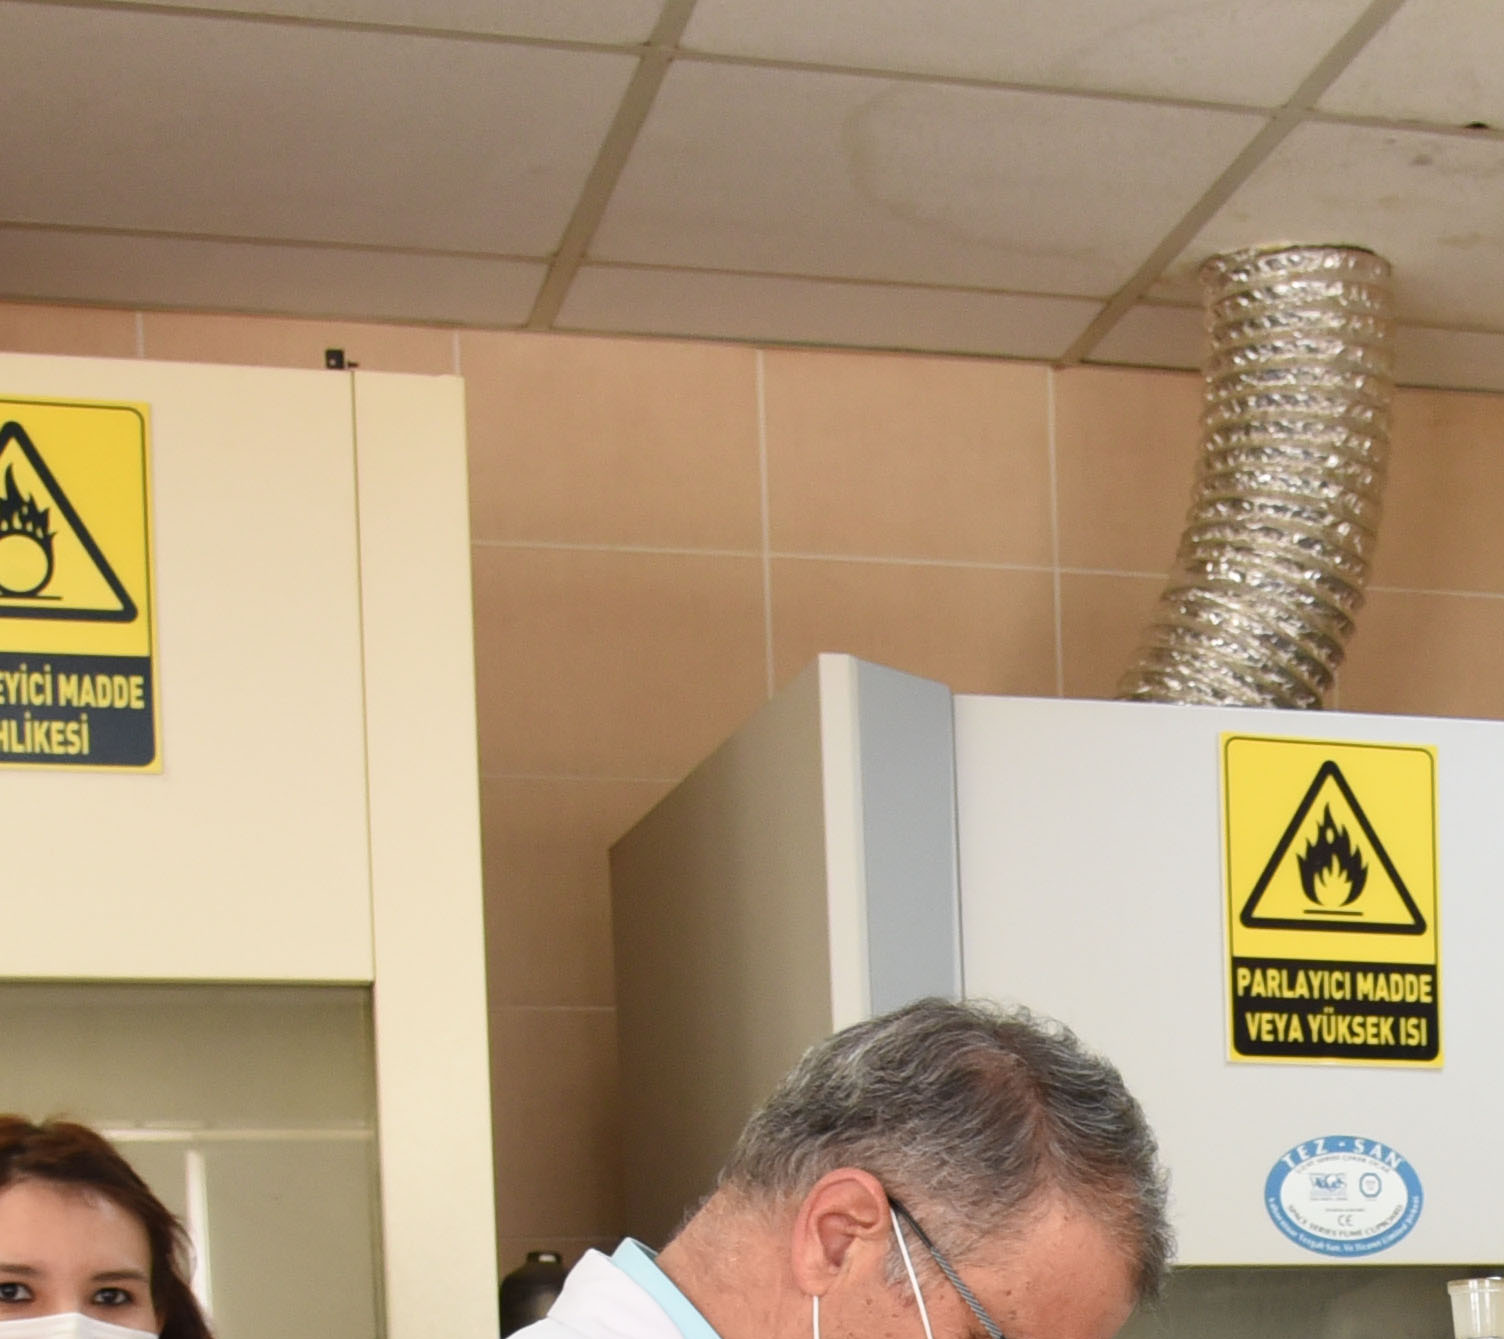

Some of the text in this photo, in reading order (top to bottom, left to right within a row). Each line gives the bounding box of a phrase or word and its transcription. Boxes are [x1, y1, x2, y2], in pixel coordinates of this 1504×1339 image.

[59, 670, 145, 711] MADDE
[1236, 966, 1433, 1004] PARLAYICI MADDE
[1245, 1006, 1428, 1048] VEYA YÜKSEK ISI
